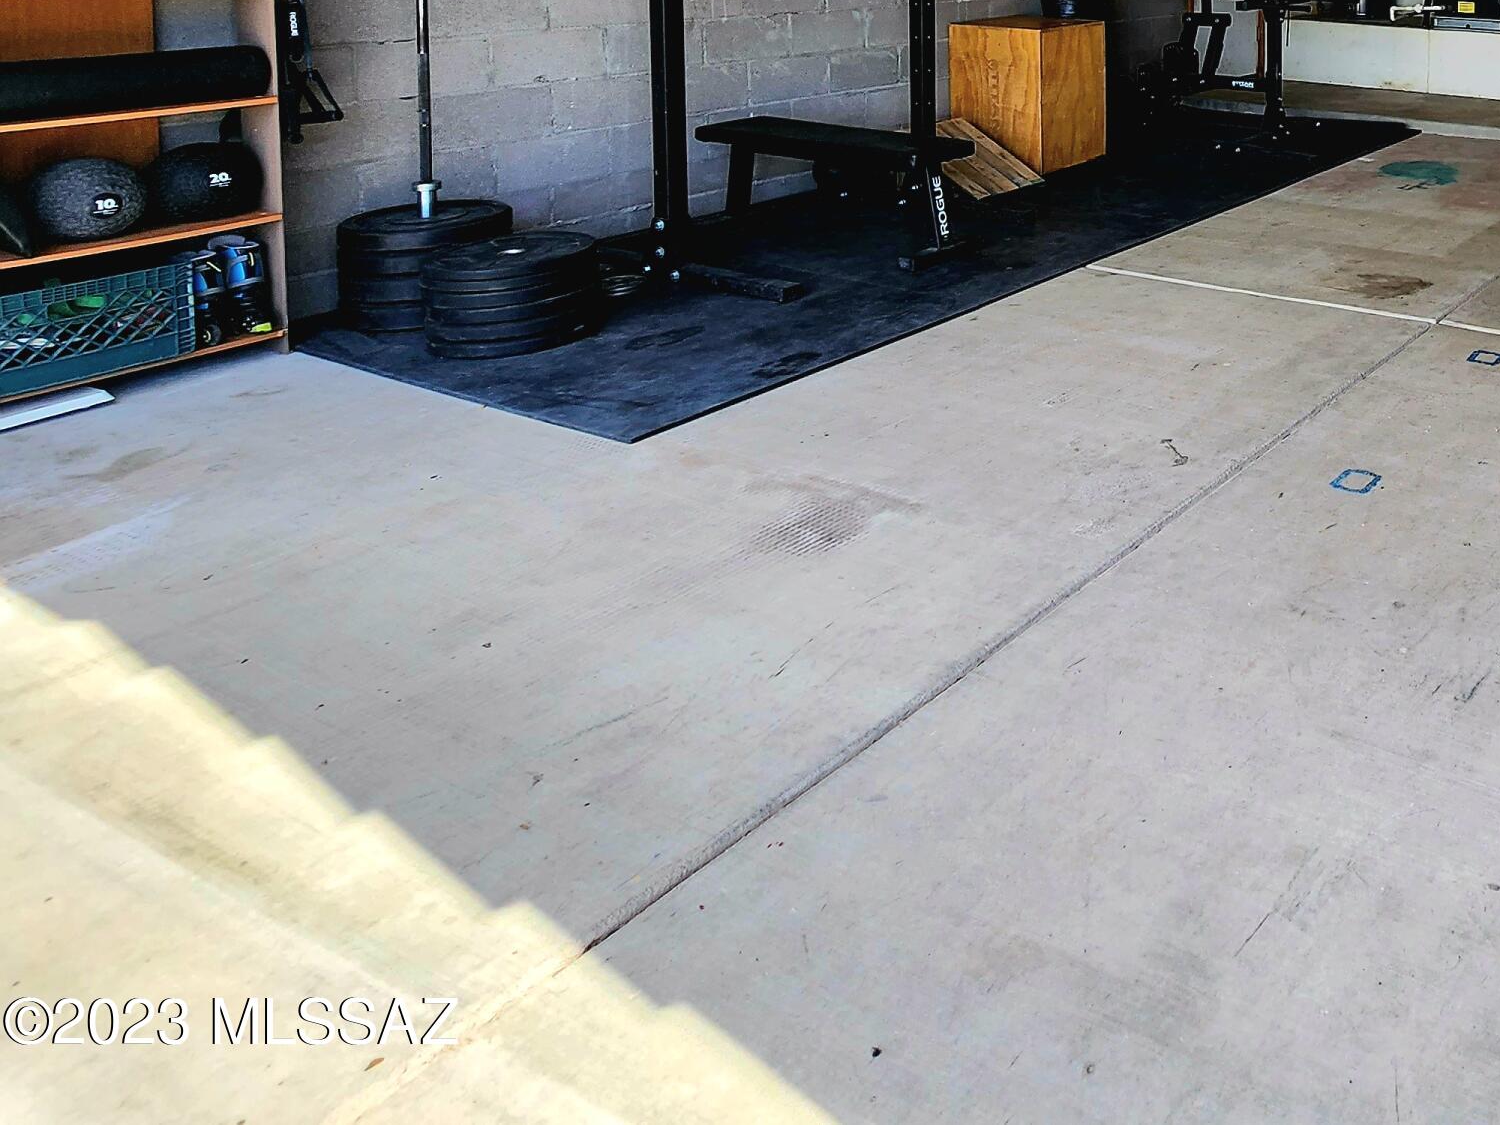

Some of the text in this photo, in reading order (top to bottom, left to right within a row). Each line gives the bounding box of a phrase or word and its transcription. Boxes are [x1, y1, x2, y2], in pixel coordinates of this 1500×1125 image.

[209, 171, 229, 184] 20
[95, 198, 116, 211] 10
[931, 175, 950, 236] ROGUE
